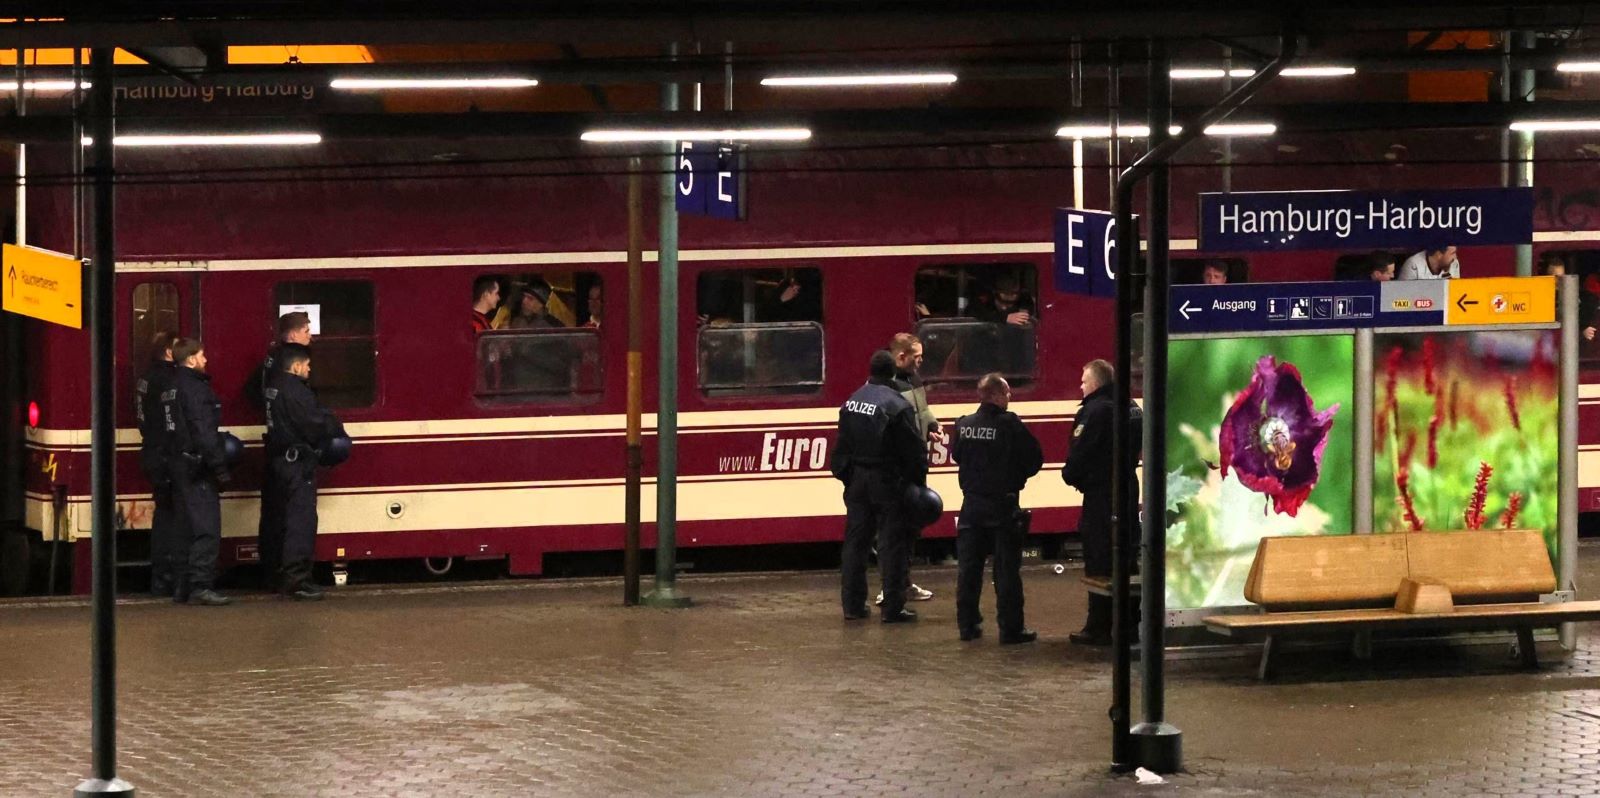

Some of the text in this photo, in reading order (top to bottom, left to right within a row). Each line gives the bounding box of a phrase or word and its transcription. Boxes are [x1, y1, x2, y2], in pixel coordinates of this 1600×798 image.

[680, 141, 694, 196] 5
[1219, 200, 1482, 238] Hamburg-Harburg
[1068, 213, 1084, 275] E
[1212, 299, 1256, 311] Ausgang
[1394, 300, 1409, 308] TAXI
[1416, 300, 1430, 308] BUS
[1512, 303, 1526, 311] WC
[960, 426, 997, 440] POLIZEI
